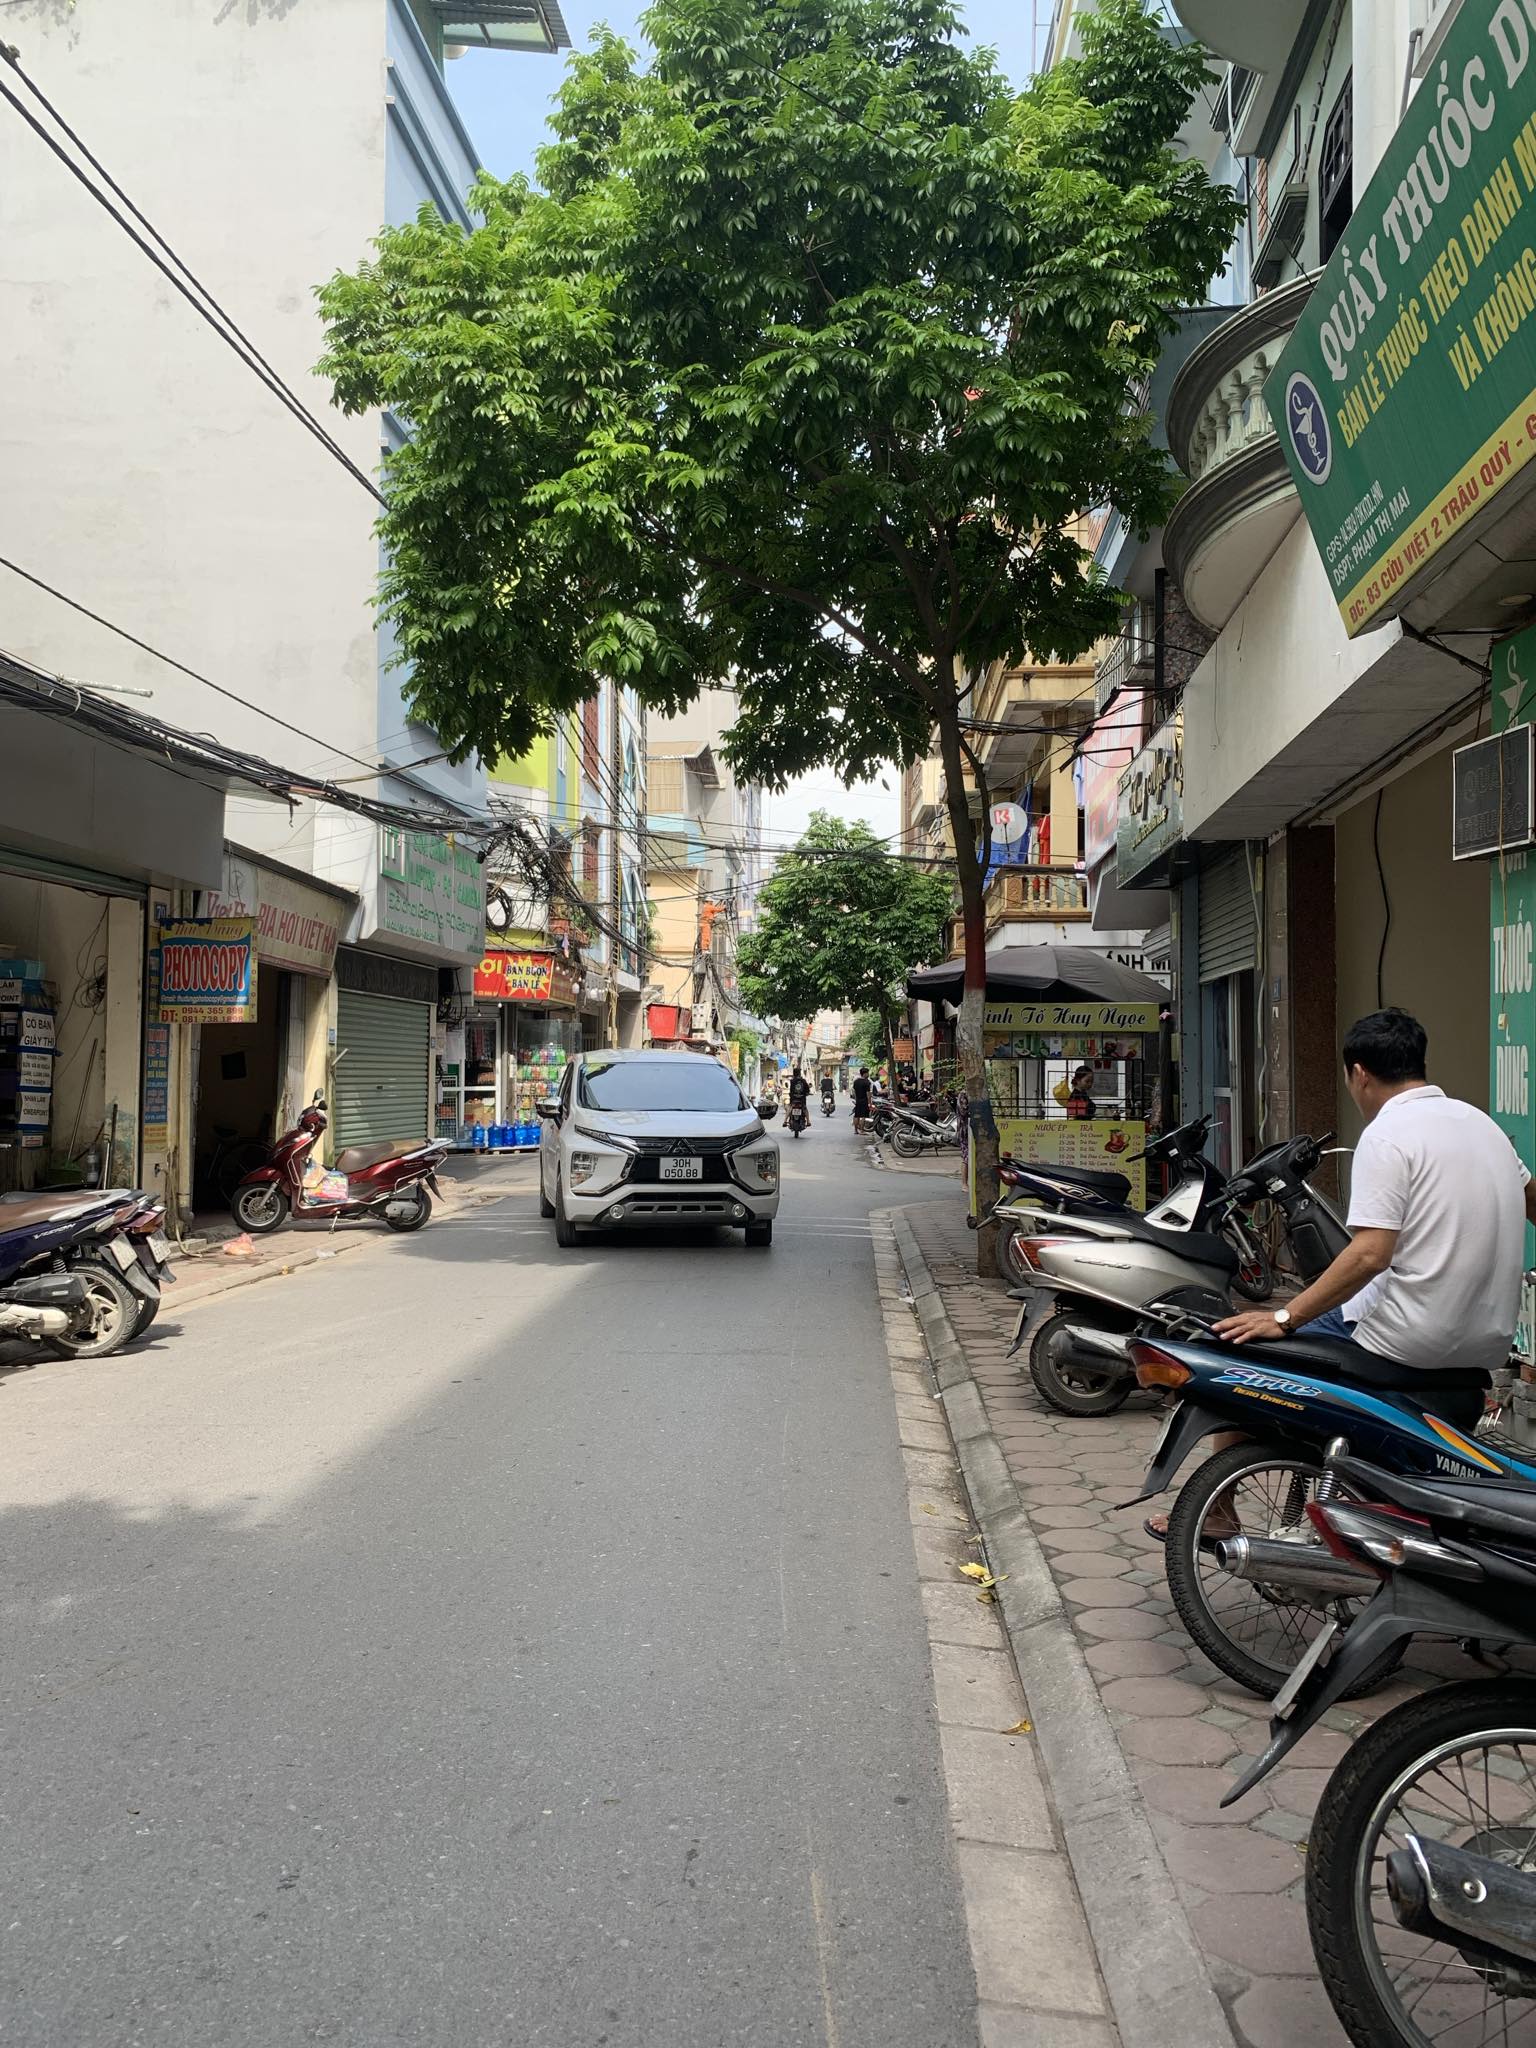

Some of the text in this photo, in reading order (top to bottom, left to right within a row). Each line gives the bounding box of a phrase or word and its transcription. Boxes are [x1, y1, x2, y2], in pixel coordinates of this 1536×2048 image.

[1320, 234, 1388, 382] QUẦY
[1382, 54, 1497, 265] THUỐC
[1336, 384, 1370, 449] BÁN
[1360, 350, 1386, 415] LẺ
[1376, 291, 1429, 390] THUỐC
[1419, 237, 1469, 326] THEO
[1460, 156, 1523, 269] DANH
[1448, 323, 1484, 392] VÀ
[1351, 524, 1378, 565] PHẠM
[1374, 507, 1394, 537] THỊ
[1388, 485, 1411, 521] MAI
[1366, 580, 1382, 600] 83
[1380, 554, 1405, 591] CỬU
[1402, 527, 1431, 565] VIỆT
[1431, 516, 1443, 540] 2
[1440, 476, 1480, 527] TRÂU
[257, 902, 279, 940] BIA
[161, 944, 249, 992] PHOTOCOPY
[1493, 898, 1534, 995] THUỐC
[161, 1009, 179, 1022] ĐT:
[984, 1006, 1147, 1029] inh Tố Huy Ngọc
[1034, 1122, 1057, 1132] NƯỚC
[665, 1168, 698, 1178] 050.88
[673, 1159, 690, 1168] 30H
[1209, 1367, 1322, 1397] Sirius
